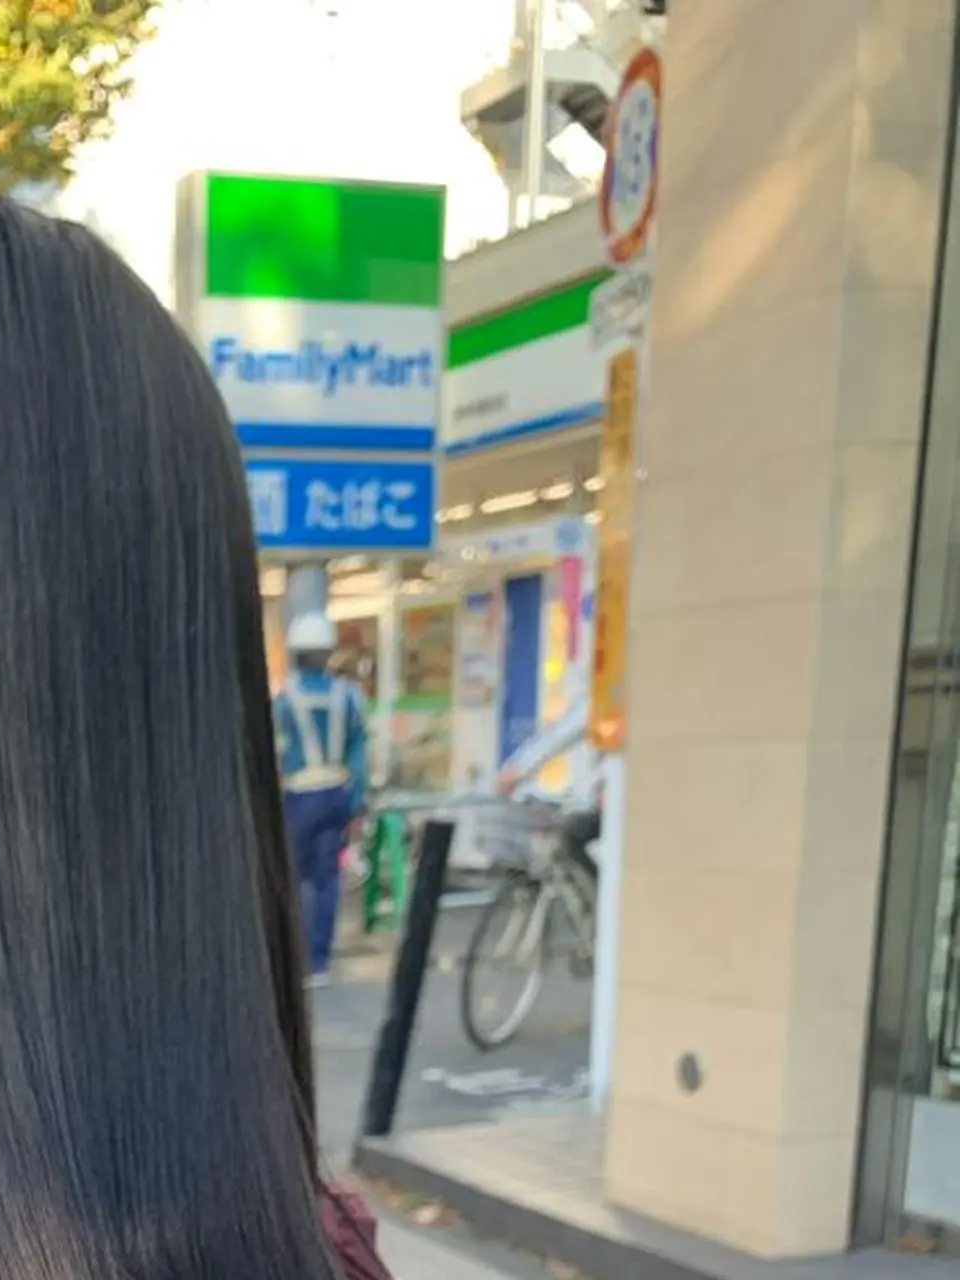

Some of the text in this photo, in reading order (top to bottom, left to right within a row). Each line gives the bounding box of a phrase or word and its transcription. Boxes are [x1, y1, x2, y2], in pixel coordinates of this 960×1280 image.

[211, 337, 433, 397] FamilyMart
[304, 478, 418, 531] たばこ
